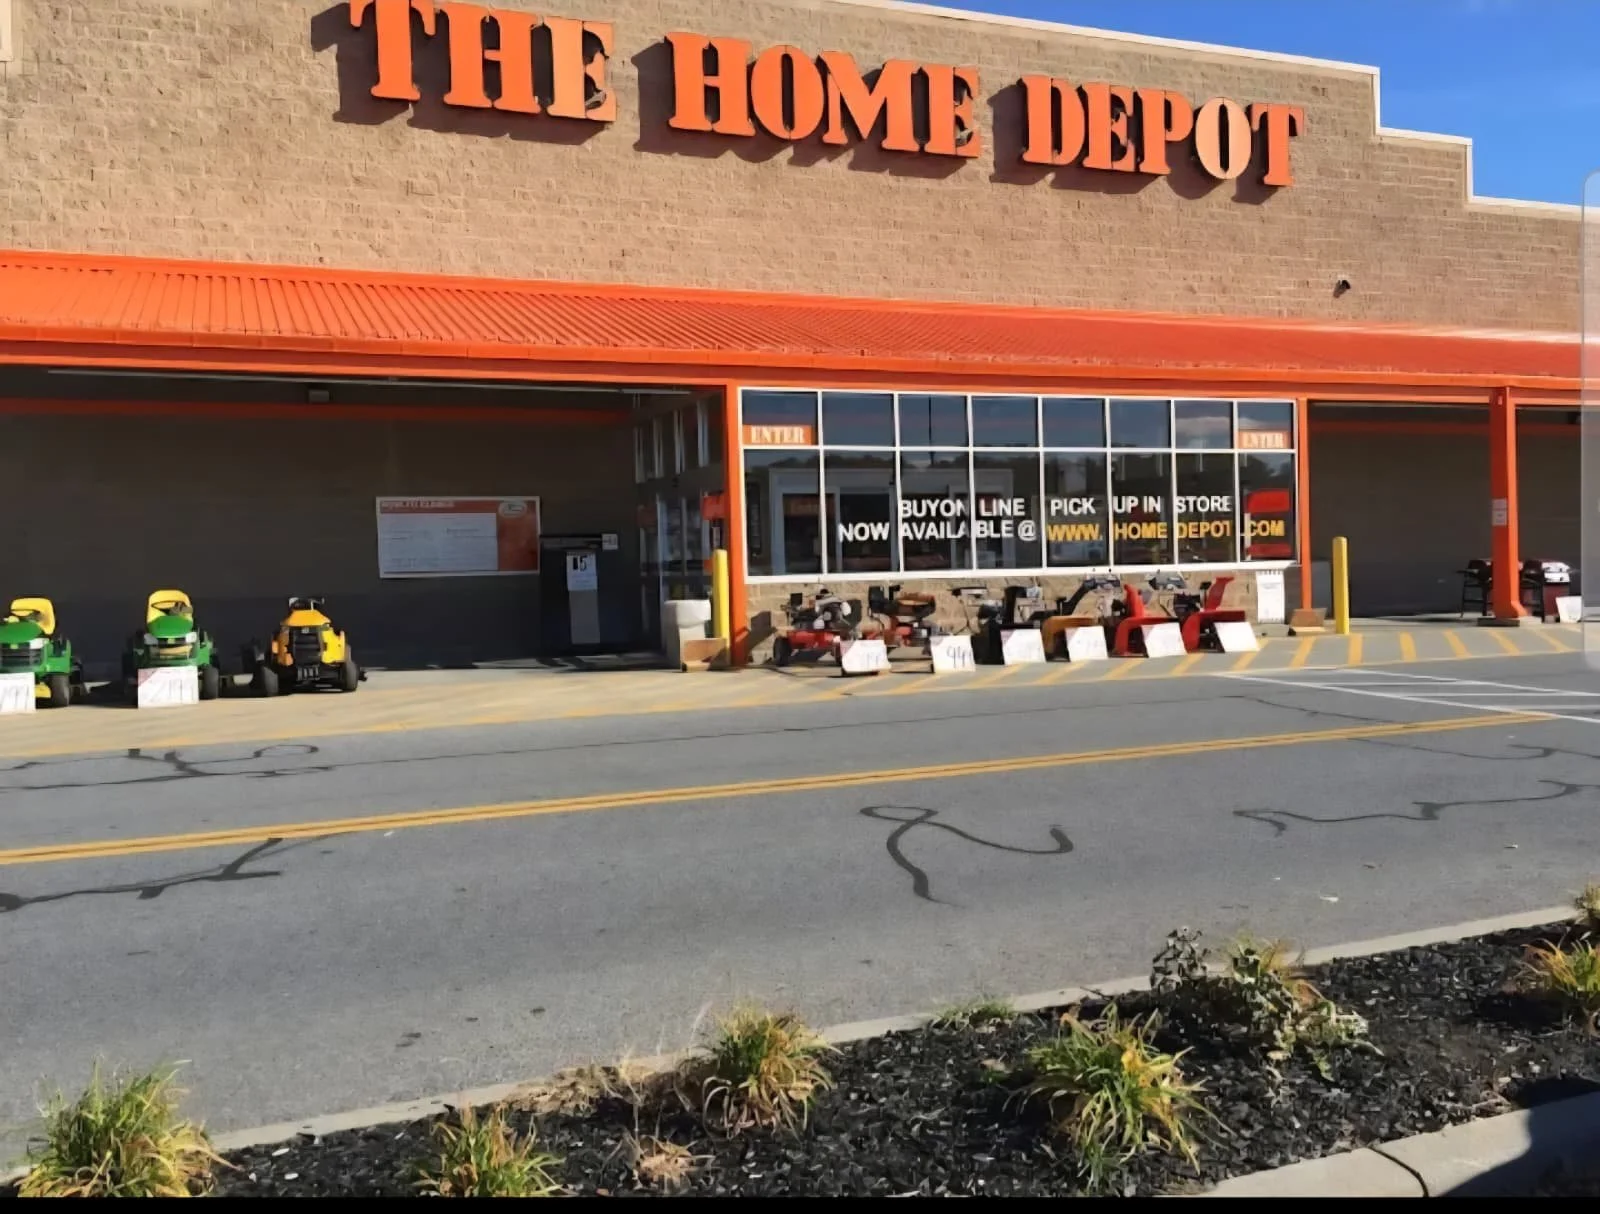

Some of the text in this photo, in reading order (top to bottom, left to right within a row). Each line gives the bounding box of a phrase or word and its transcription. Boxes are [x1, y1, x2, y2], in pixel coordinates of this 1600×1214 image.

[350, 0, 1304, 187] THE HOME DEPOT
[751, 425, 805, 444] ENTER
[1241, 432, 1284, 448] ENTER
[979, 497, 1026, 516] LINE
[1050, 496, 1096, 517] PICK
[1112, 495, 1139, 514] UP
[1143, 495, 1161, 513] IN
[1175, 495, 1233, 513] STORE
[838, 521, 889, 543] NOW
[1017, 519, 1037, 541] @
